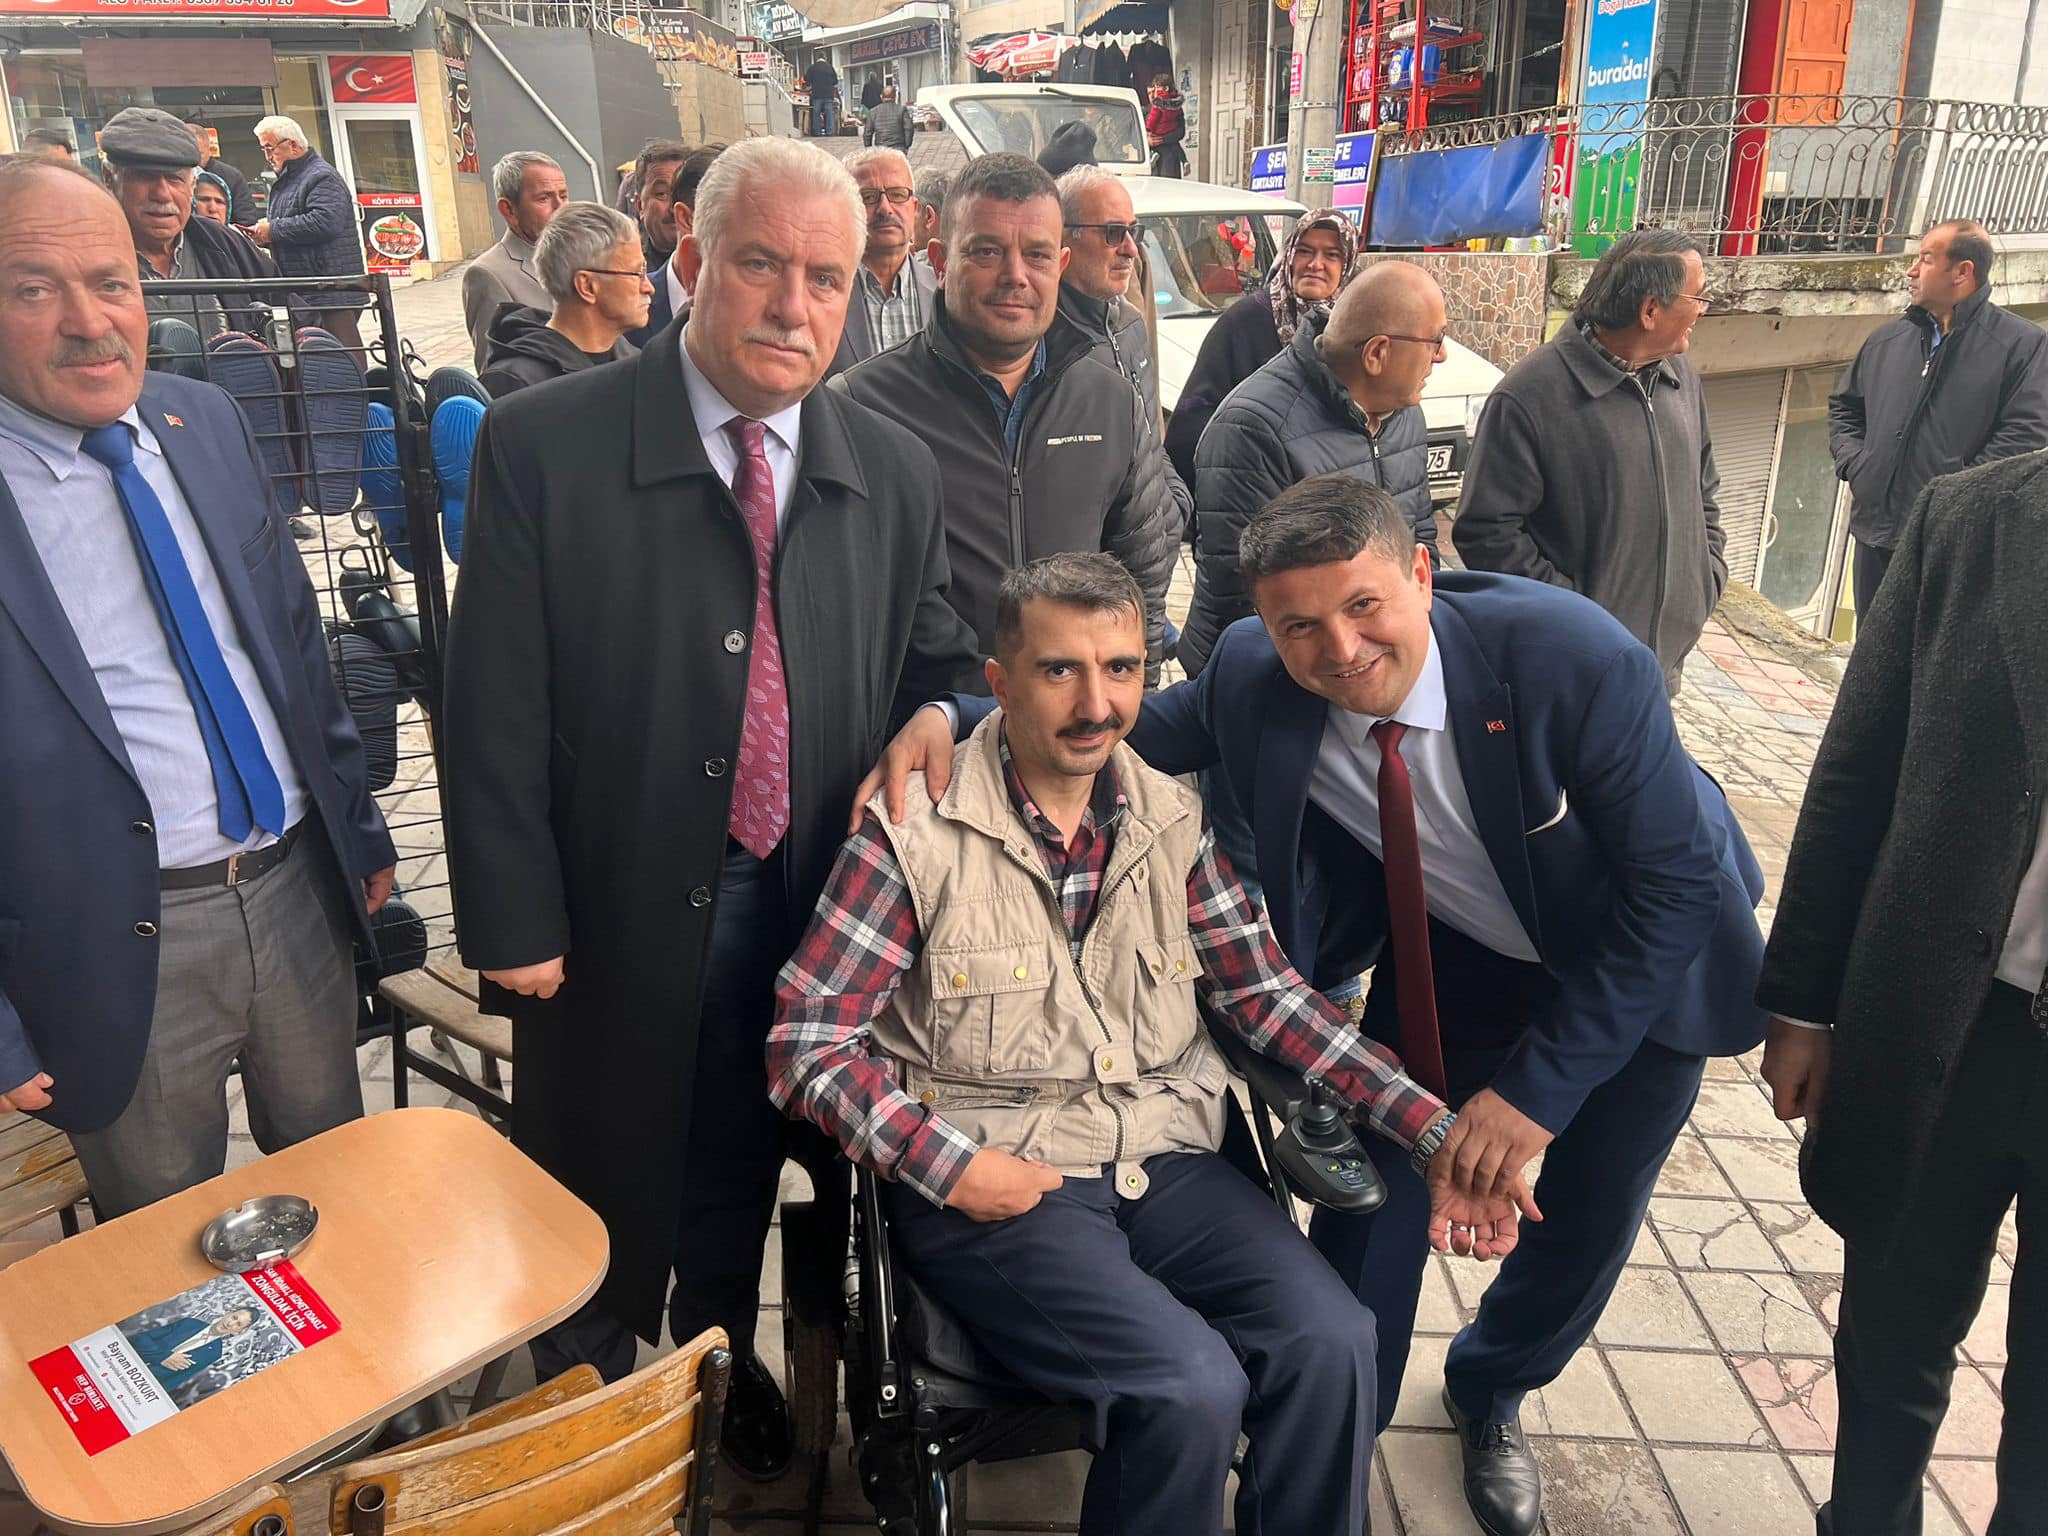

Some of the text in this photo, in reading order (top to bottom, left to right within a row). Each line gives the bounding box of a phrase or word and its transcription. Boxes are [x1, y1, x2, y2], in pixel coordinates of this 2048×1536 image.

[1588, 57, 1648, 87] burada!
[250, 1273, 309, 1332] ZONGULDAK İÇİN
[106, 1340, 131, 1371] Bayram
[125, 1366, 159, 1404] BOZKURT
